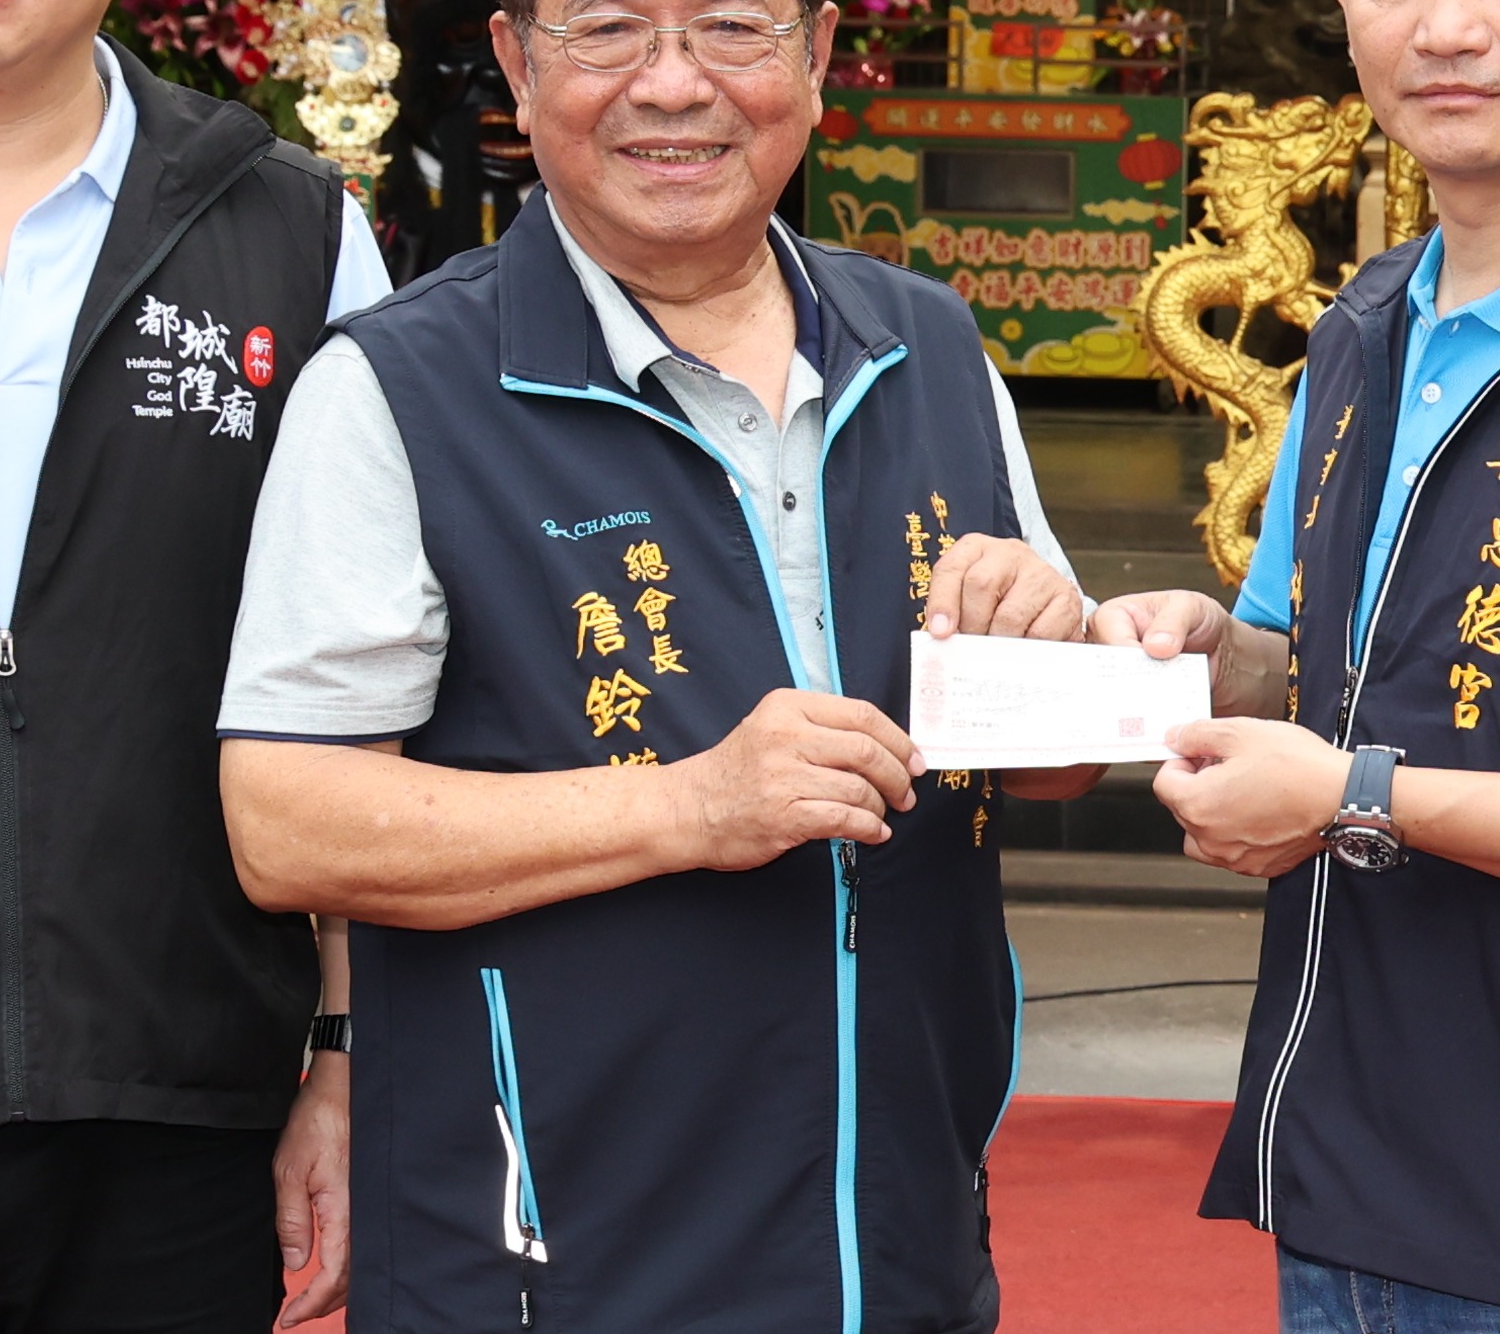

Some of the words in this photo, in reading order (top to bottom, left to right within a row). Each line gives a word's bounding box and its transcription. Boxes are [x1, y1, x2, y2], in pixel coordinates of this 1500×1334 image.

[125, 356, 173, 370] Hsinchu
[249, 335, 272, 379] 新竹
[146, 371, 173, 386] City
[146, 389, 173, 403] God
[131, 404, 174, 419] Temple
[574, 511, 651, 538] CHAMOIS
[623, 538, 689, 675] 總會長
[571, 590, 659, 767] 詹鈴
